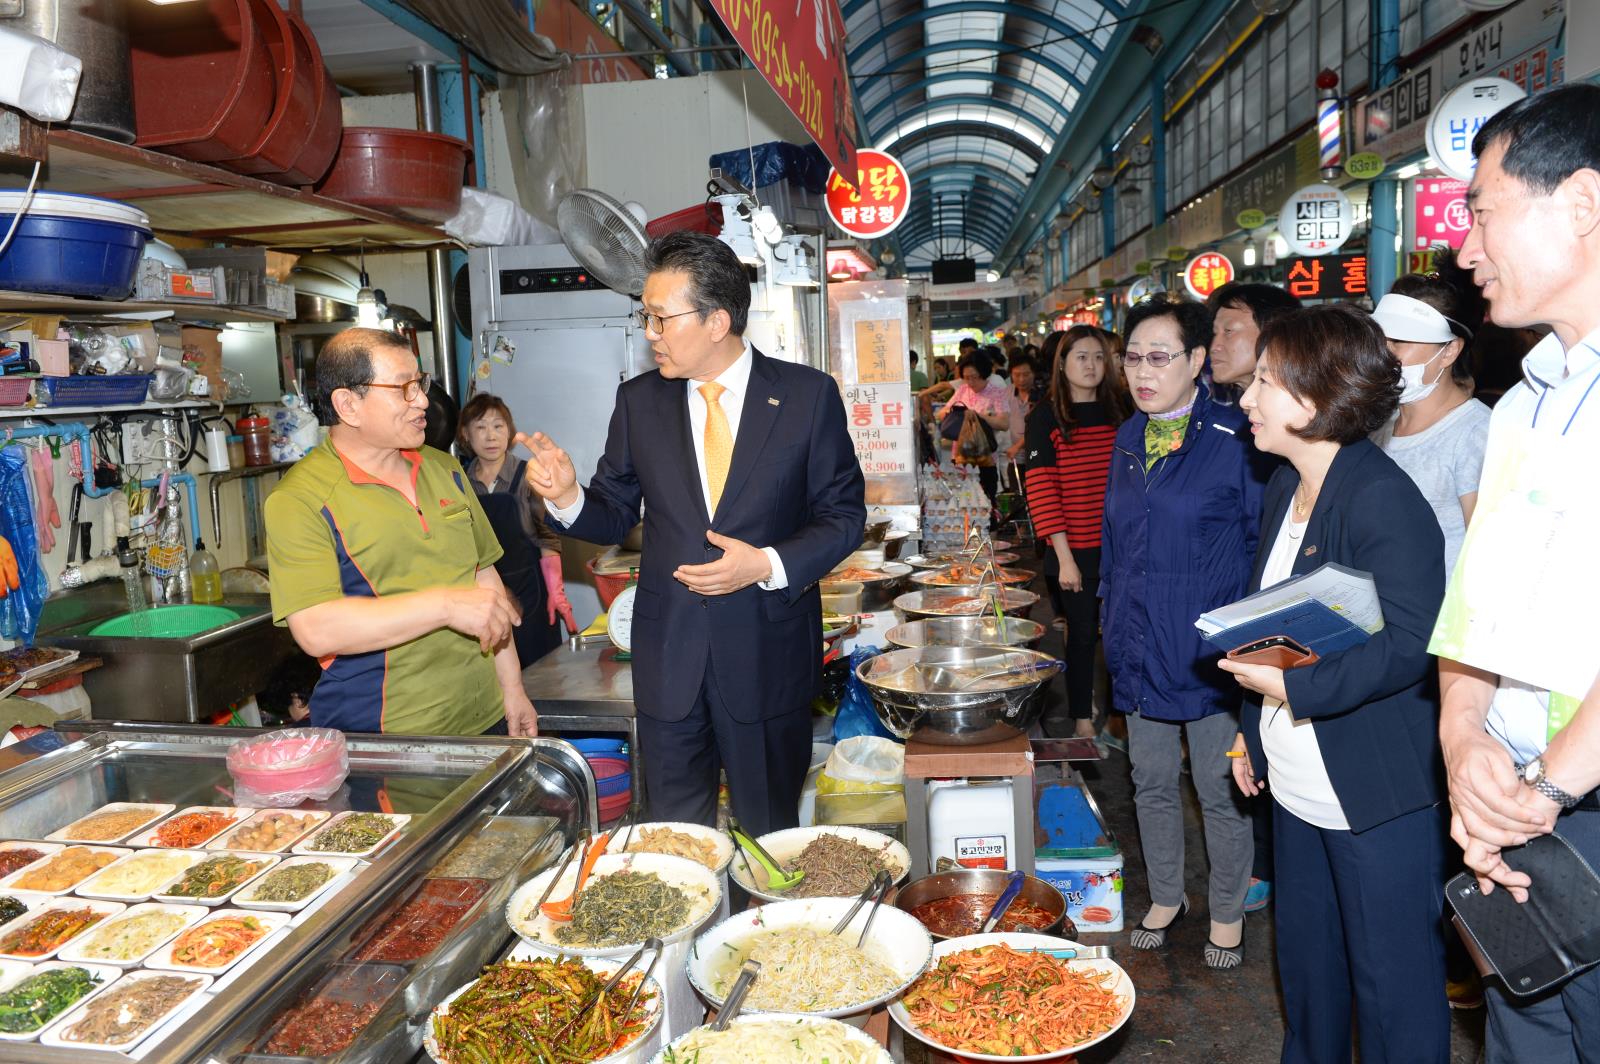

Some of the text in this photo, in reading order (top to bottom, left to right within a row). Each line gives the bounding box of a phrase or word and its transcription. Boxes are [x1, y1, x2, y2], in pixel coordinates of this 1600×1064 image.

[721, 0, 823, 139] -8954-9120
[1364, 66, 1432, 146] 의류
[841, 205, 895, 224] 닭강정
[1296, 201, 1340, 219] 서울
[1296, 221, 1340, 240] 의류
[1193, 266, 1227, 291] 족발
[852, 402, 903, 427] 통닭
